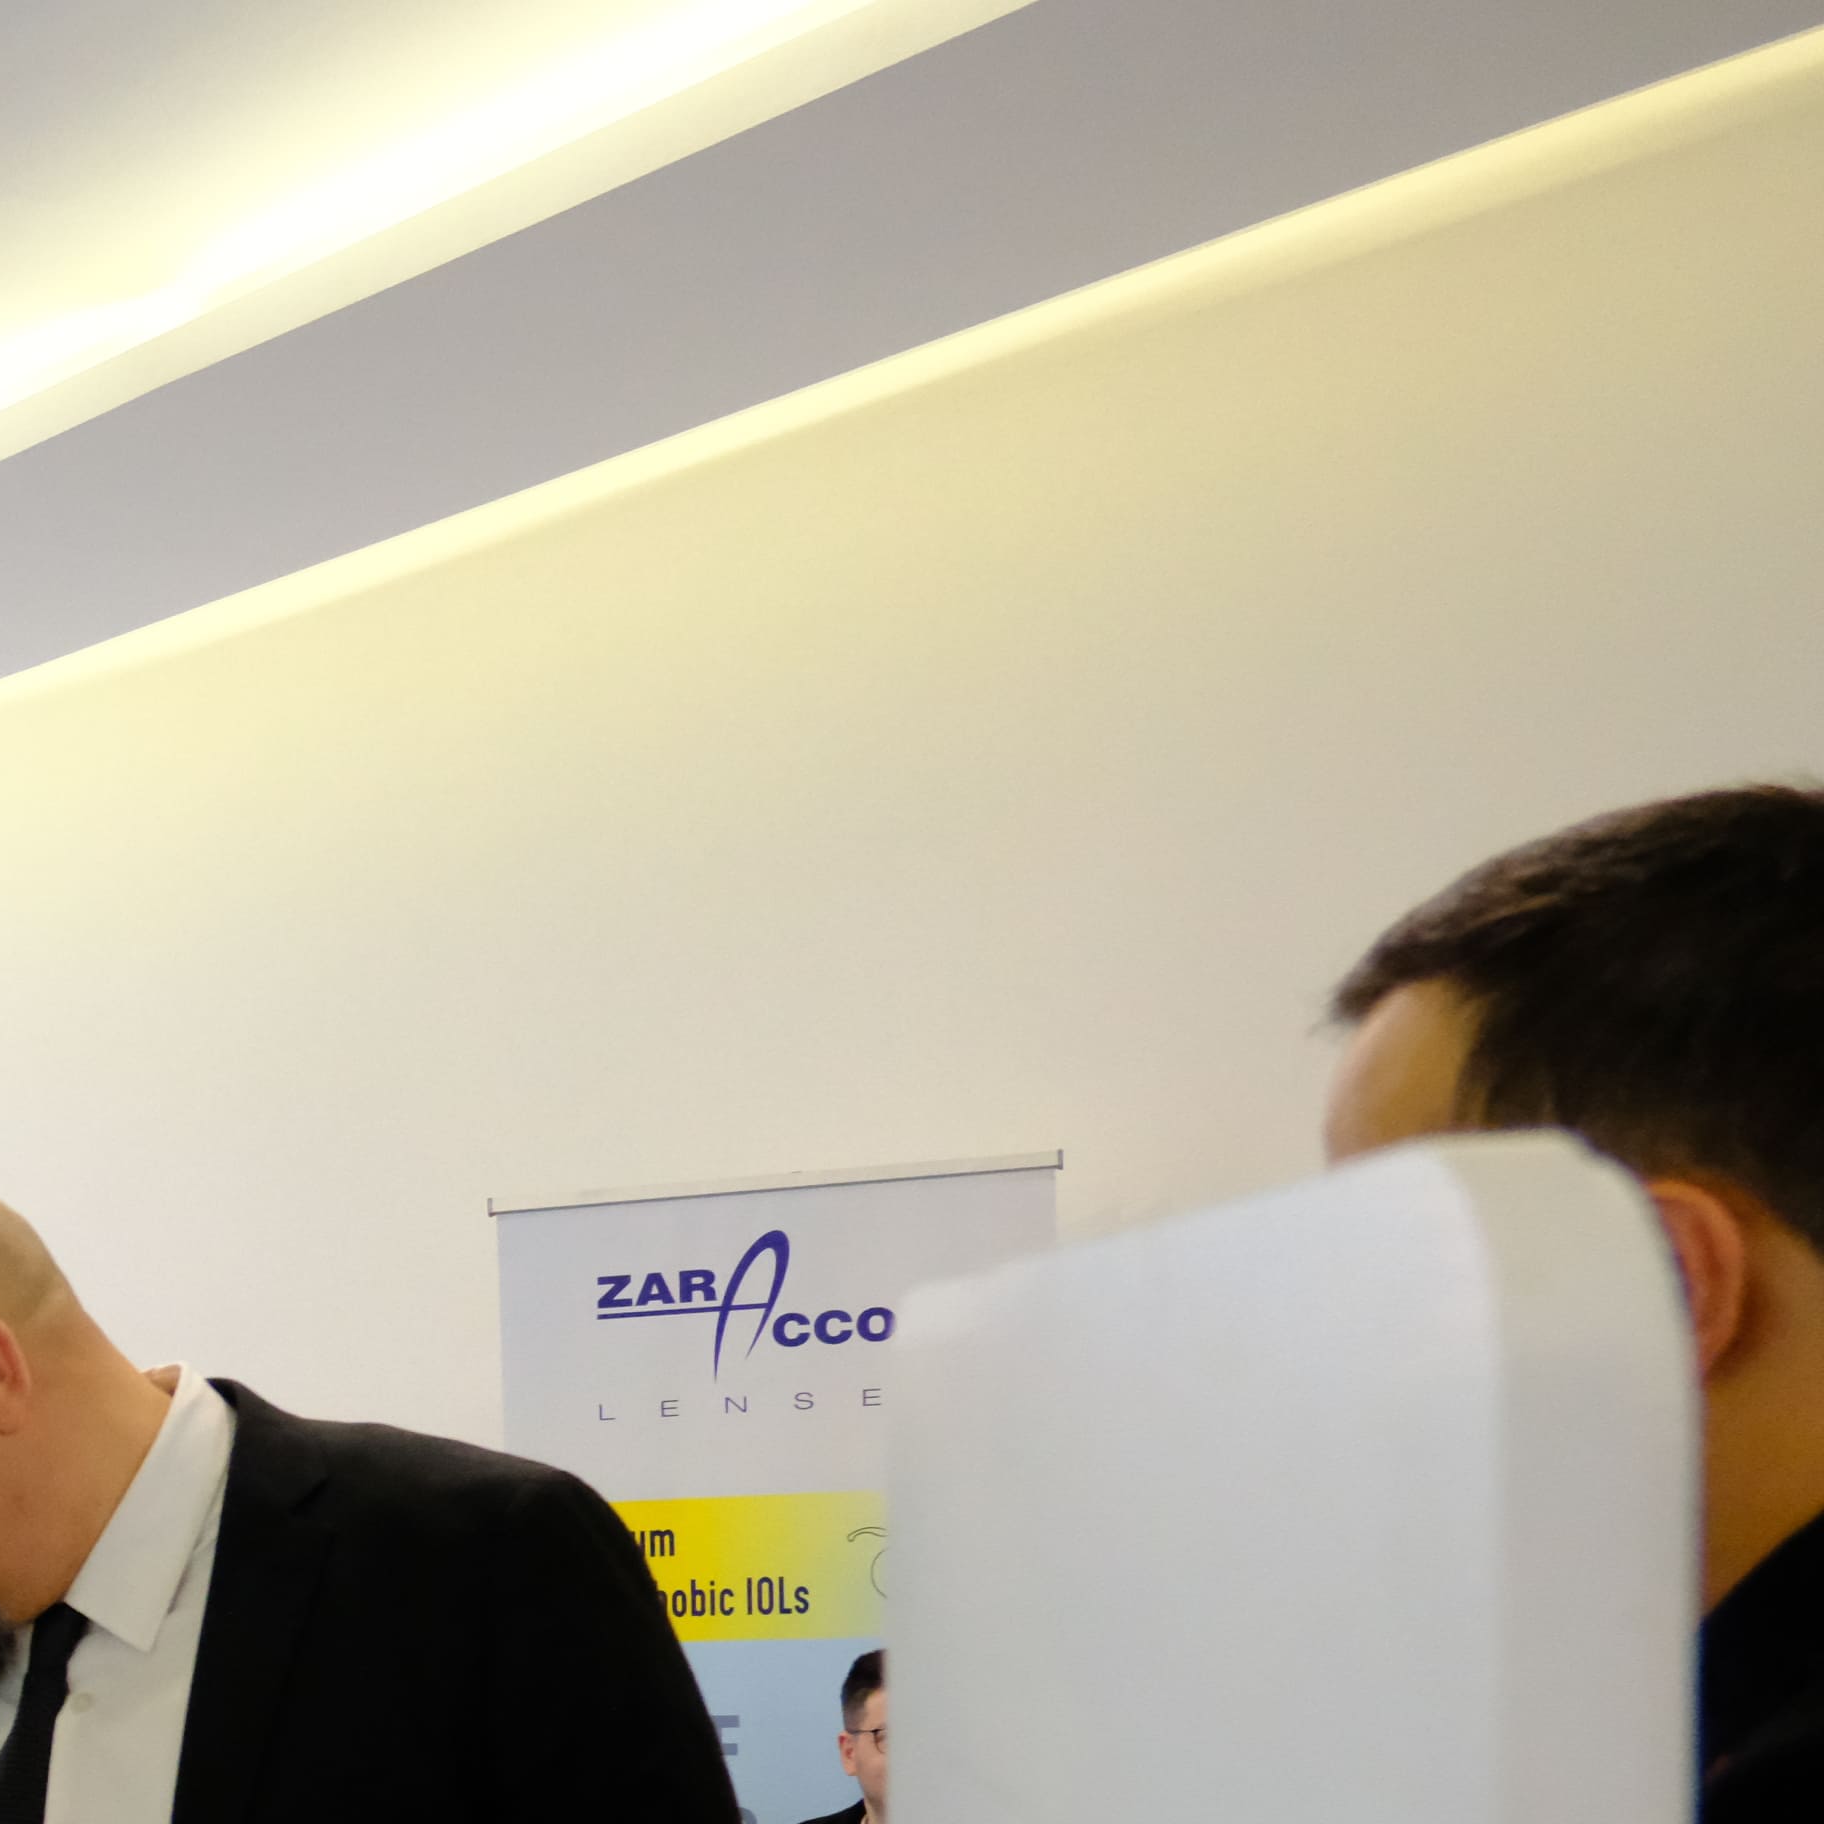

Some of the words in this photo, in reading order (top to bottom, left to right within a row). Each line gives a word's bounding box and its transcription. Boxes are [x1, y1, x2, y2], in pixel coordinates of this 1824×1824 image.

[597, 1230, 896, 1383] ZARACCO
[598, 1388, 883, 1421] LENSE
[746, 1576, 810, 1616] IOLs
